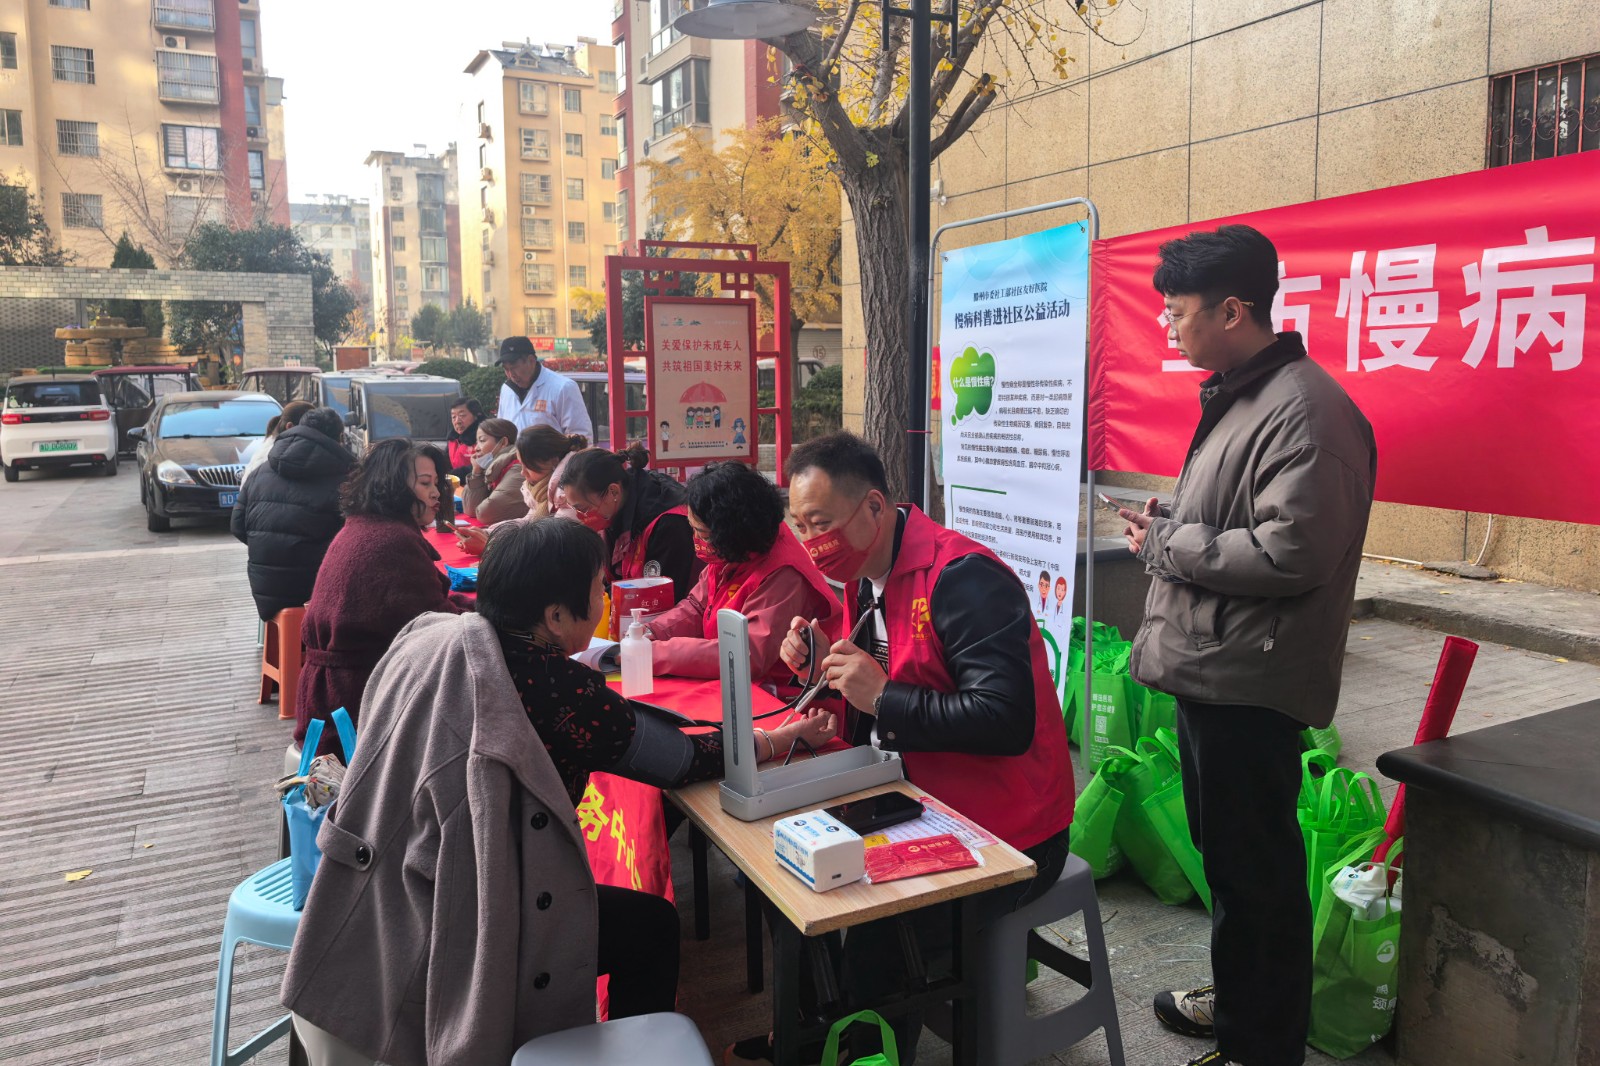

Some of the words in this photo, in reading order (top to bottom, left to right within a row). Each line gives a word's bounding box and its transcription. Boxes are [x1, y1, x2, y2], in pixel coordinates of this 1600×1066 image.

[955, 299, 1070, 329] 慢病科普进社区公益活动
[662, 339, 742, 351] 关爱保护未成年人
[663, 360, 742, 372] 共筑祖国美好未来
